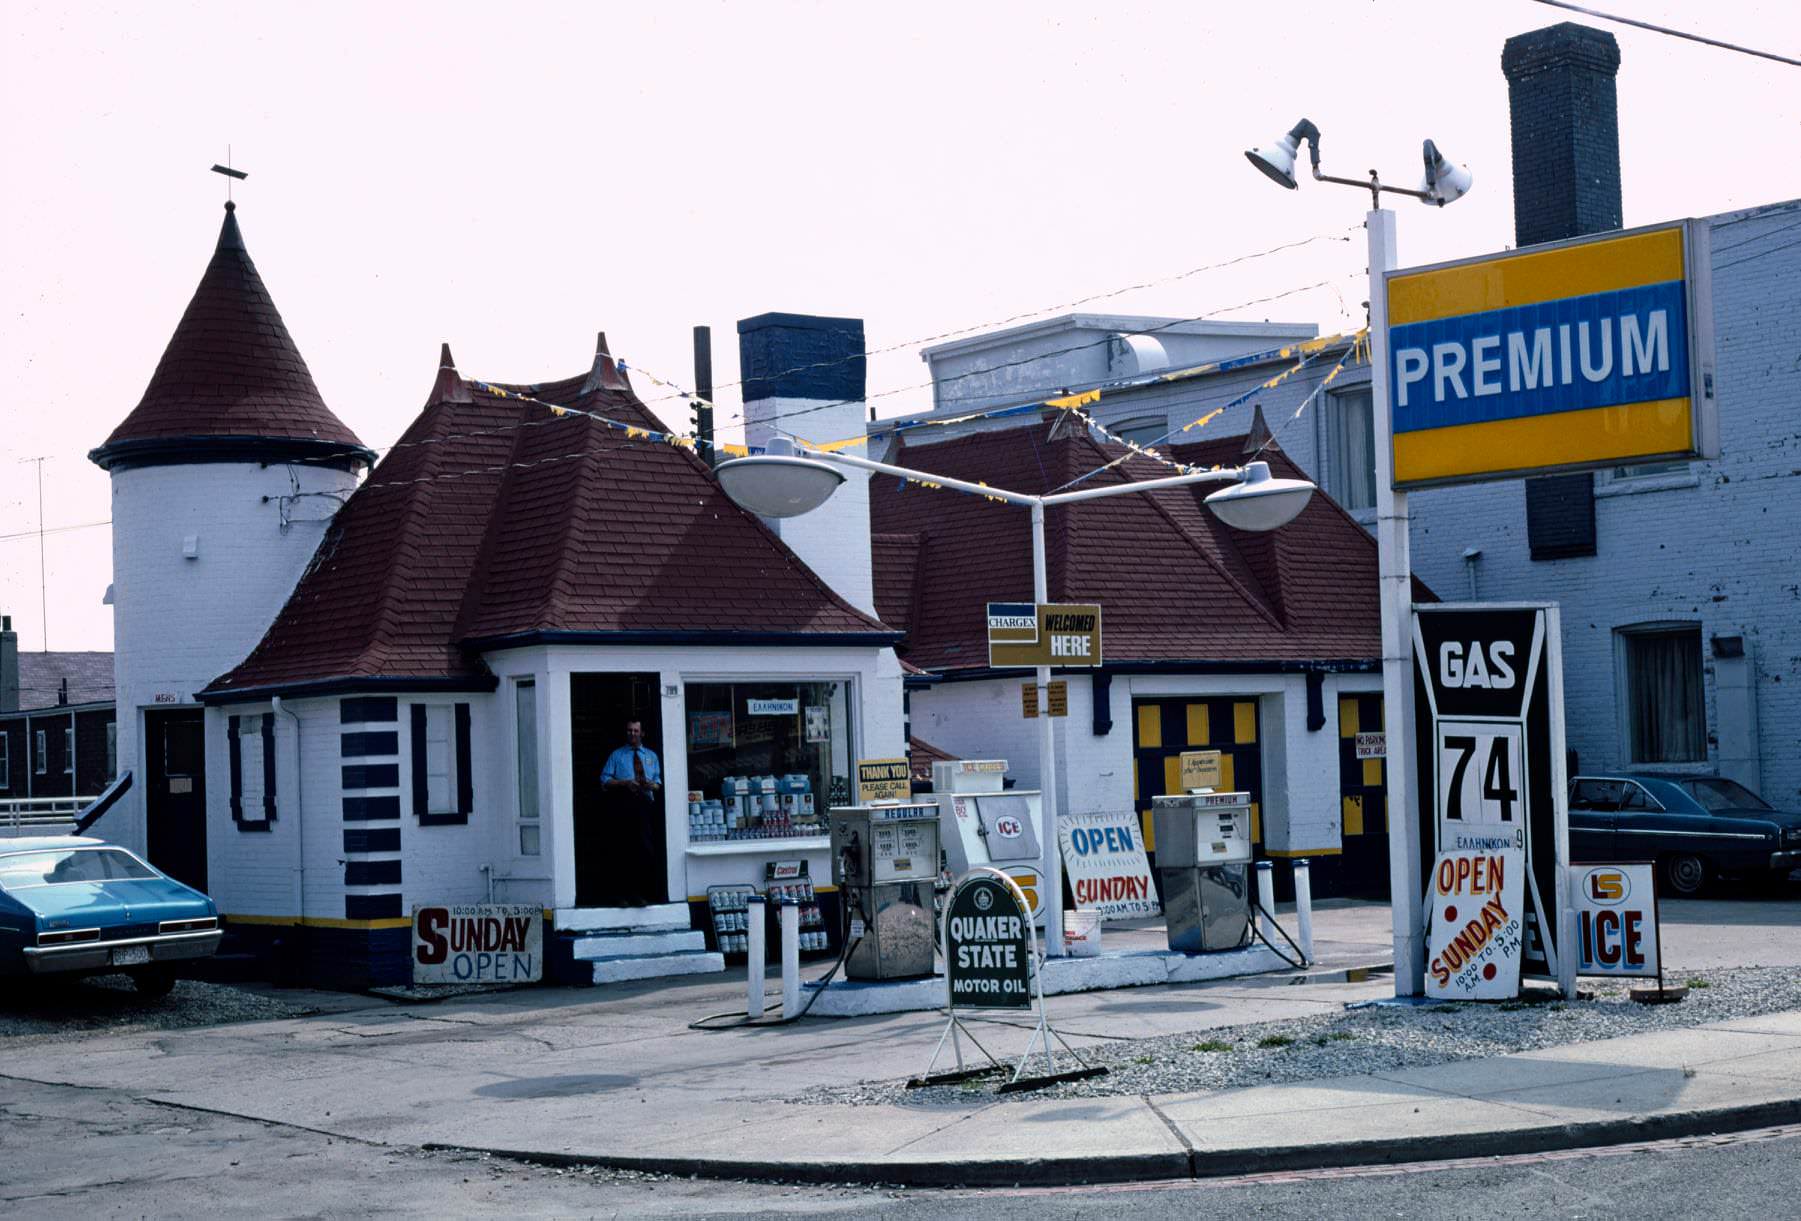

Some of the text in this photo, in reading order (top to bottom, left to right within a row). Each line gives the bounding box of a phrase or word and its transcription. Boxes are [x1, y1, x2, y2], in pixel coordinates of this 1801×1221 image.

[1395, 309, 1670, 407] PREMIUM
[988, 616, 1036, 628] CHARGEX
[1045, 614, 1096, 632] WELCOMED
[1050, 635, 1091, 656] HERE
[1440, 641, 1516, 689] GAS
[860, 764, 907, 780] THANK YOU
[861, 781, 906, 791] PLEASE CALL
[1444, 735, 1518, 822] 74
[884, 807, 924, 818] REGULAR
[1206, 795, 1238, 804] PREMIUM
[997, 821, 1020, 835] ICE
[1071, 826, 1135, 856] OPEN
[1076, 875, 1149, 904] SUNDAY
[1436, 855, 1505, 896] OPEN
[416, 907, 531, 965] SUNDAY
[950, 915, 1022, 943] QUAKER
[1431, 891, 1509, 988] SUNDAY
[1576, 909, 1646, 970] ICE
[453, 952, 532, 980] OPEN
[958, 945, 1018, 969] STATE
[954, 979, 1027, 993] MOTOR OIL
